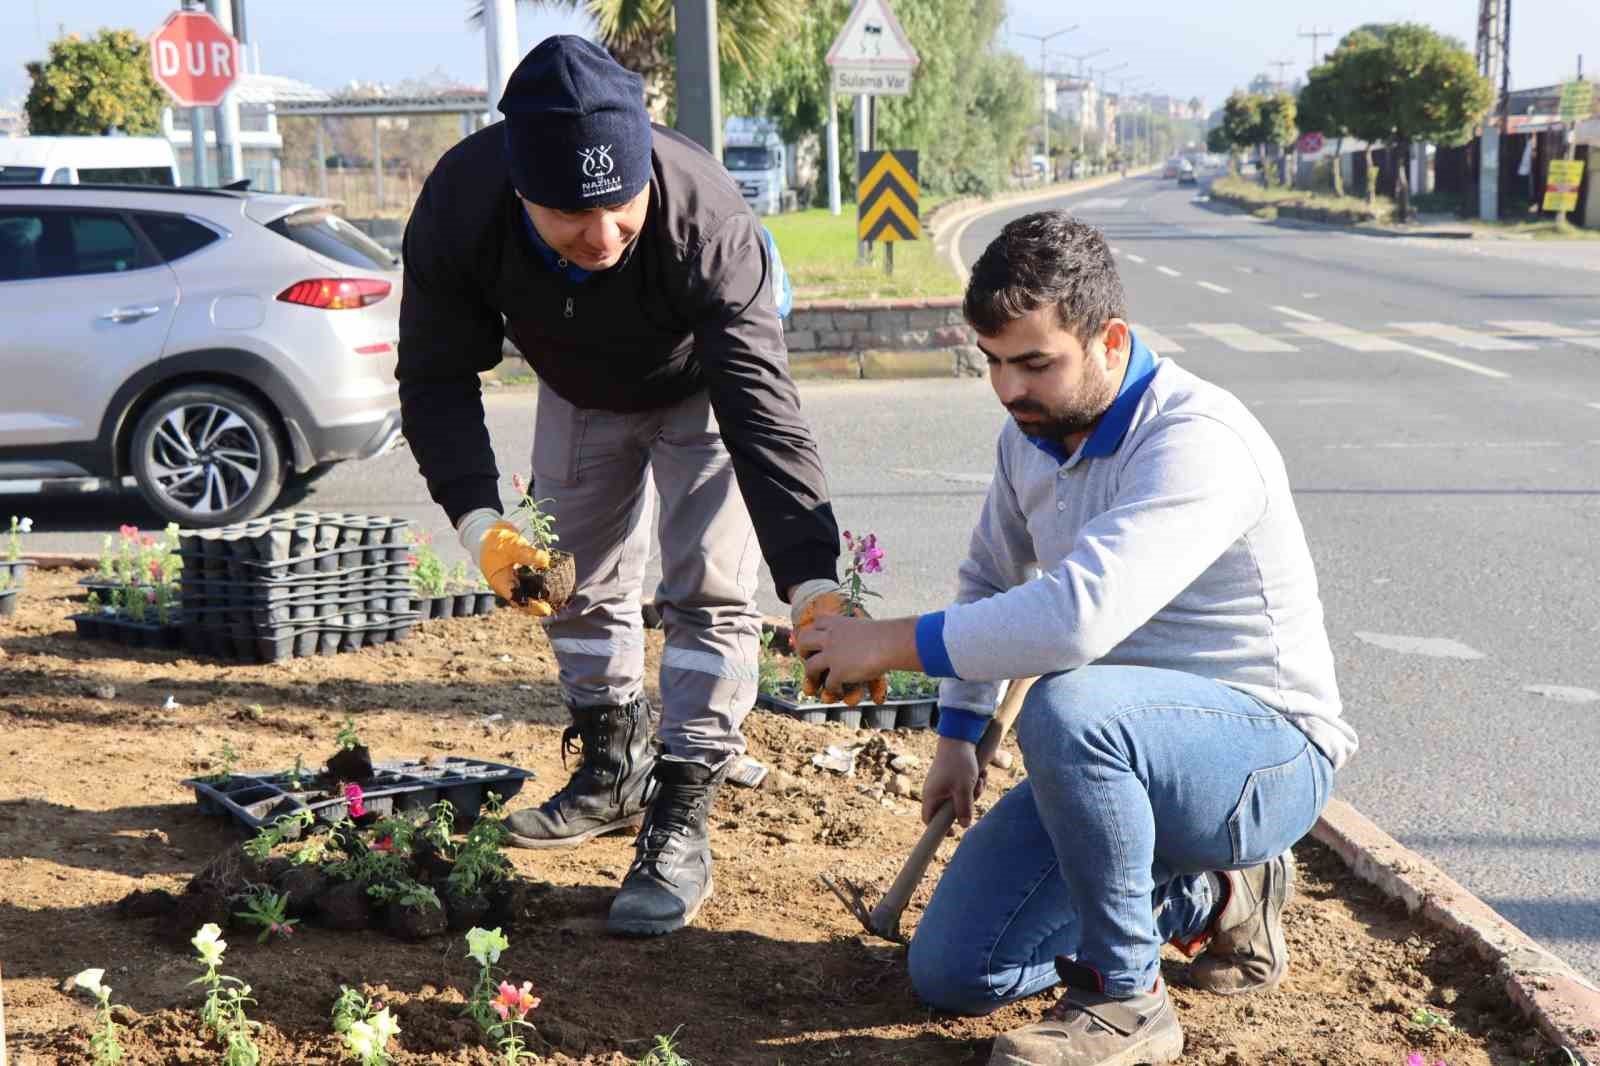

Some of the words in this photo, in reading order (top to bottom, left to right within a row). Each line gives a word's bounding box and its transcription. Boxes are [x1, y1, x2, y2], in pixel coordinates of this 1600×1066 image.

[159, 40, 232, 77] DUR
[839, 73, 882, 88] Sulama
[885, 74, 905, 88] Var
